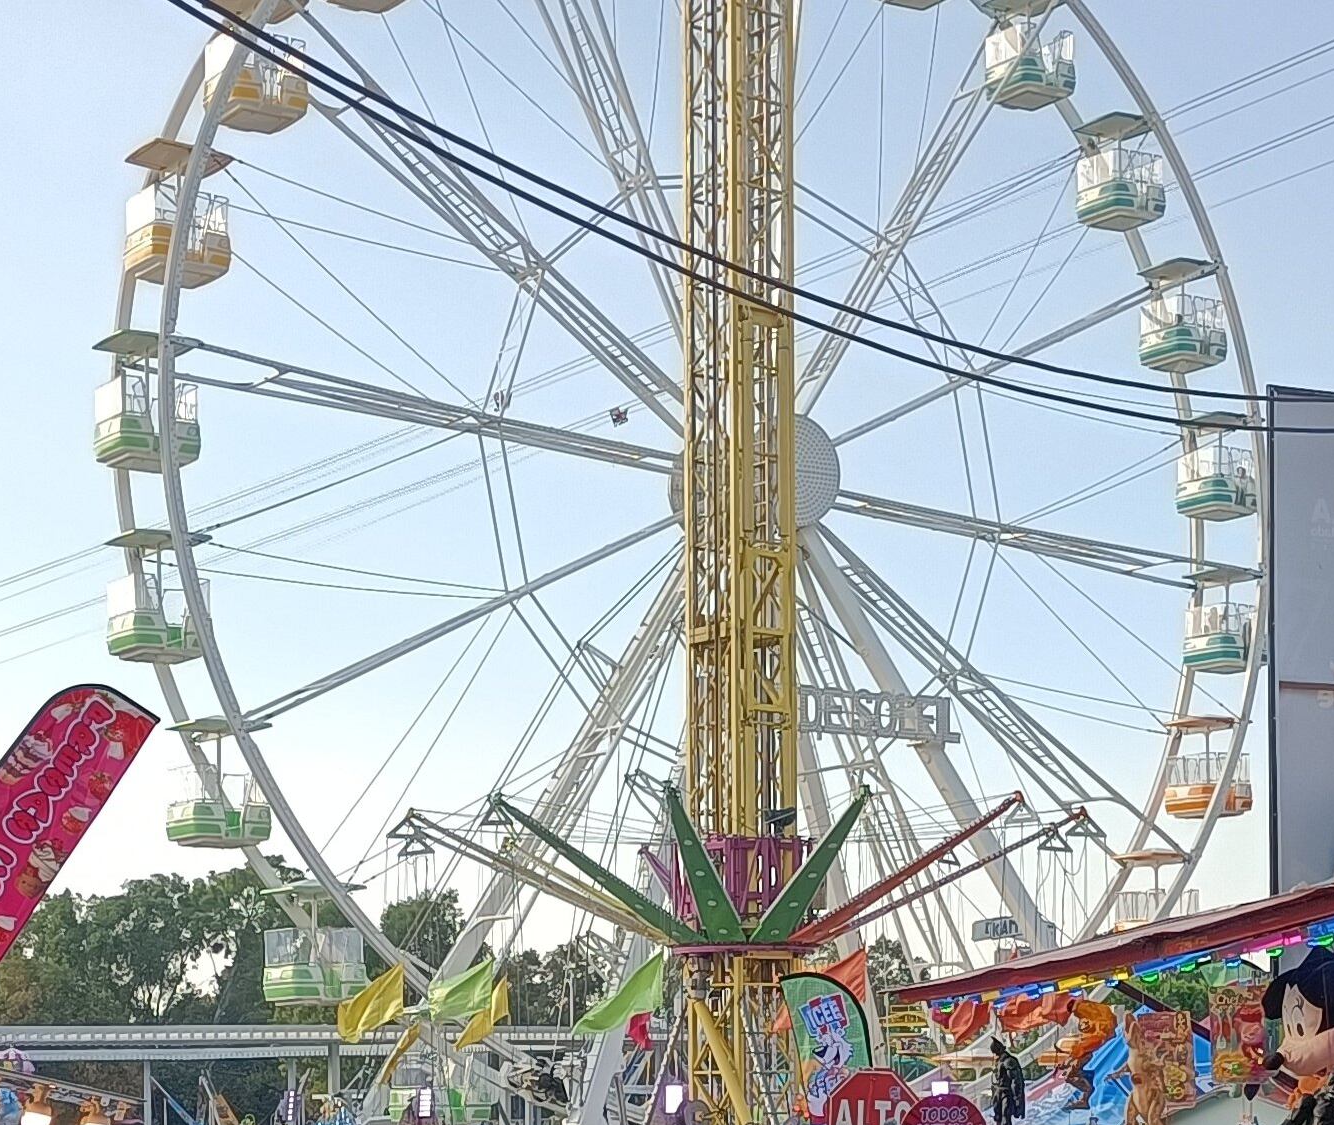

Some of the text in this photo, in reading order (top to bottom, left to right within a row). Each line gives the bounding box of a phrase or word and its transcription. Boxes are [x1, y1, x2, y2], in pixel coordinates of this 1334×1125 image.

[4, 698, 115, 843] FRESAS
[806, 999, 844, 1029] ICEE
[920, 1106, 968, 1122] TODOS
